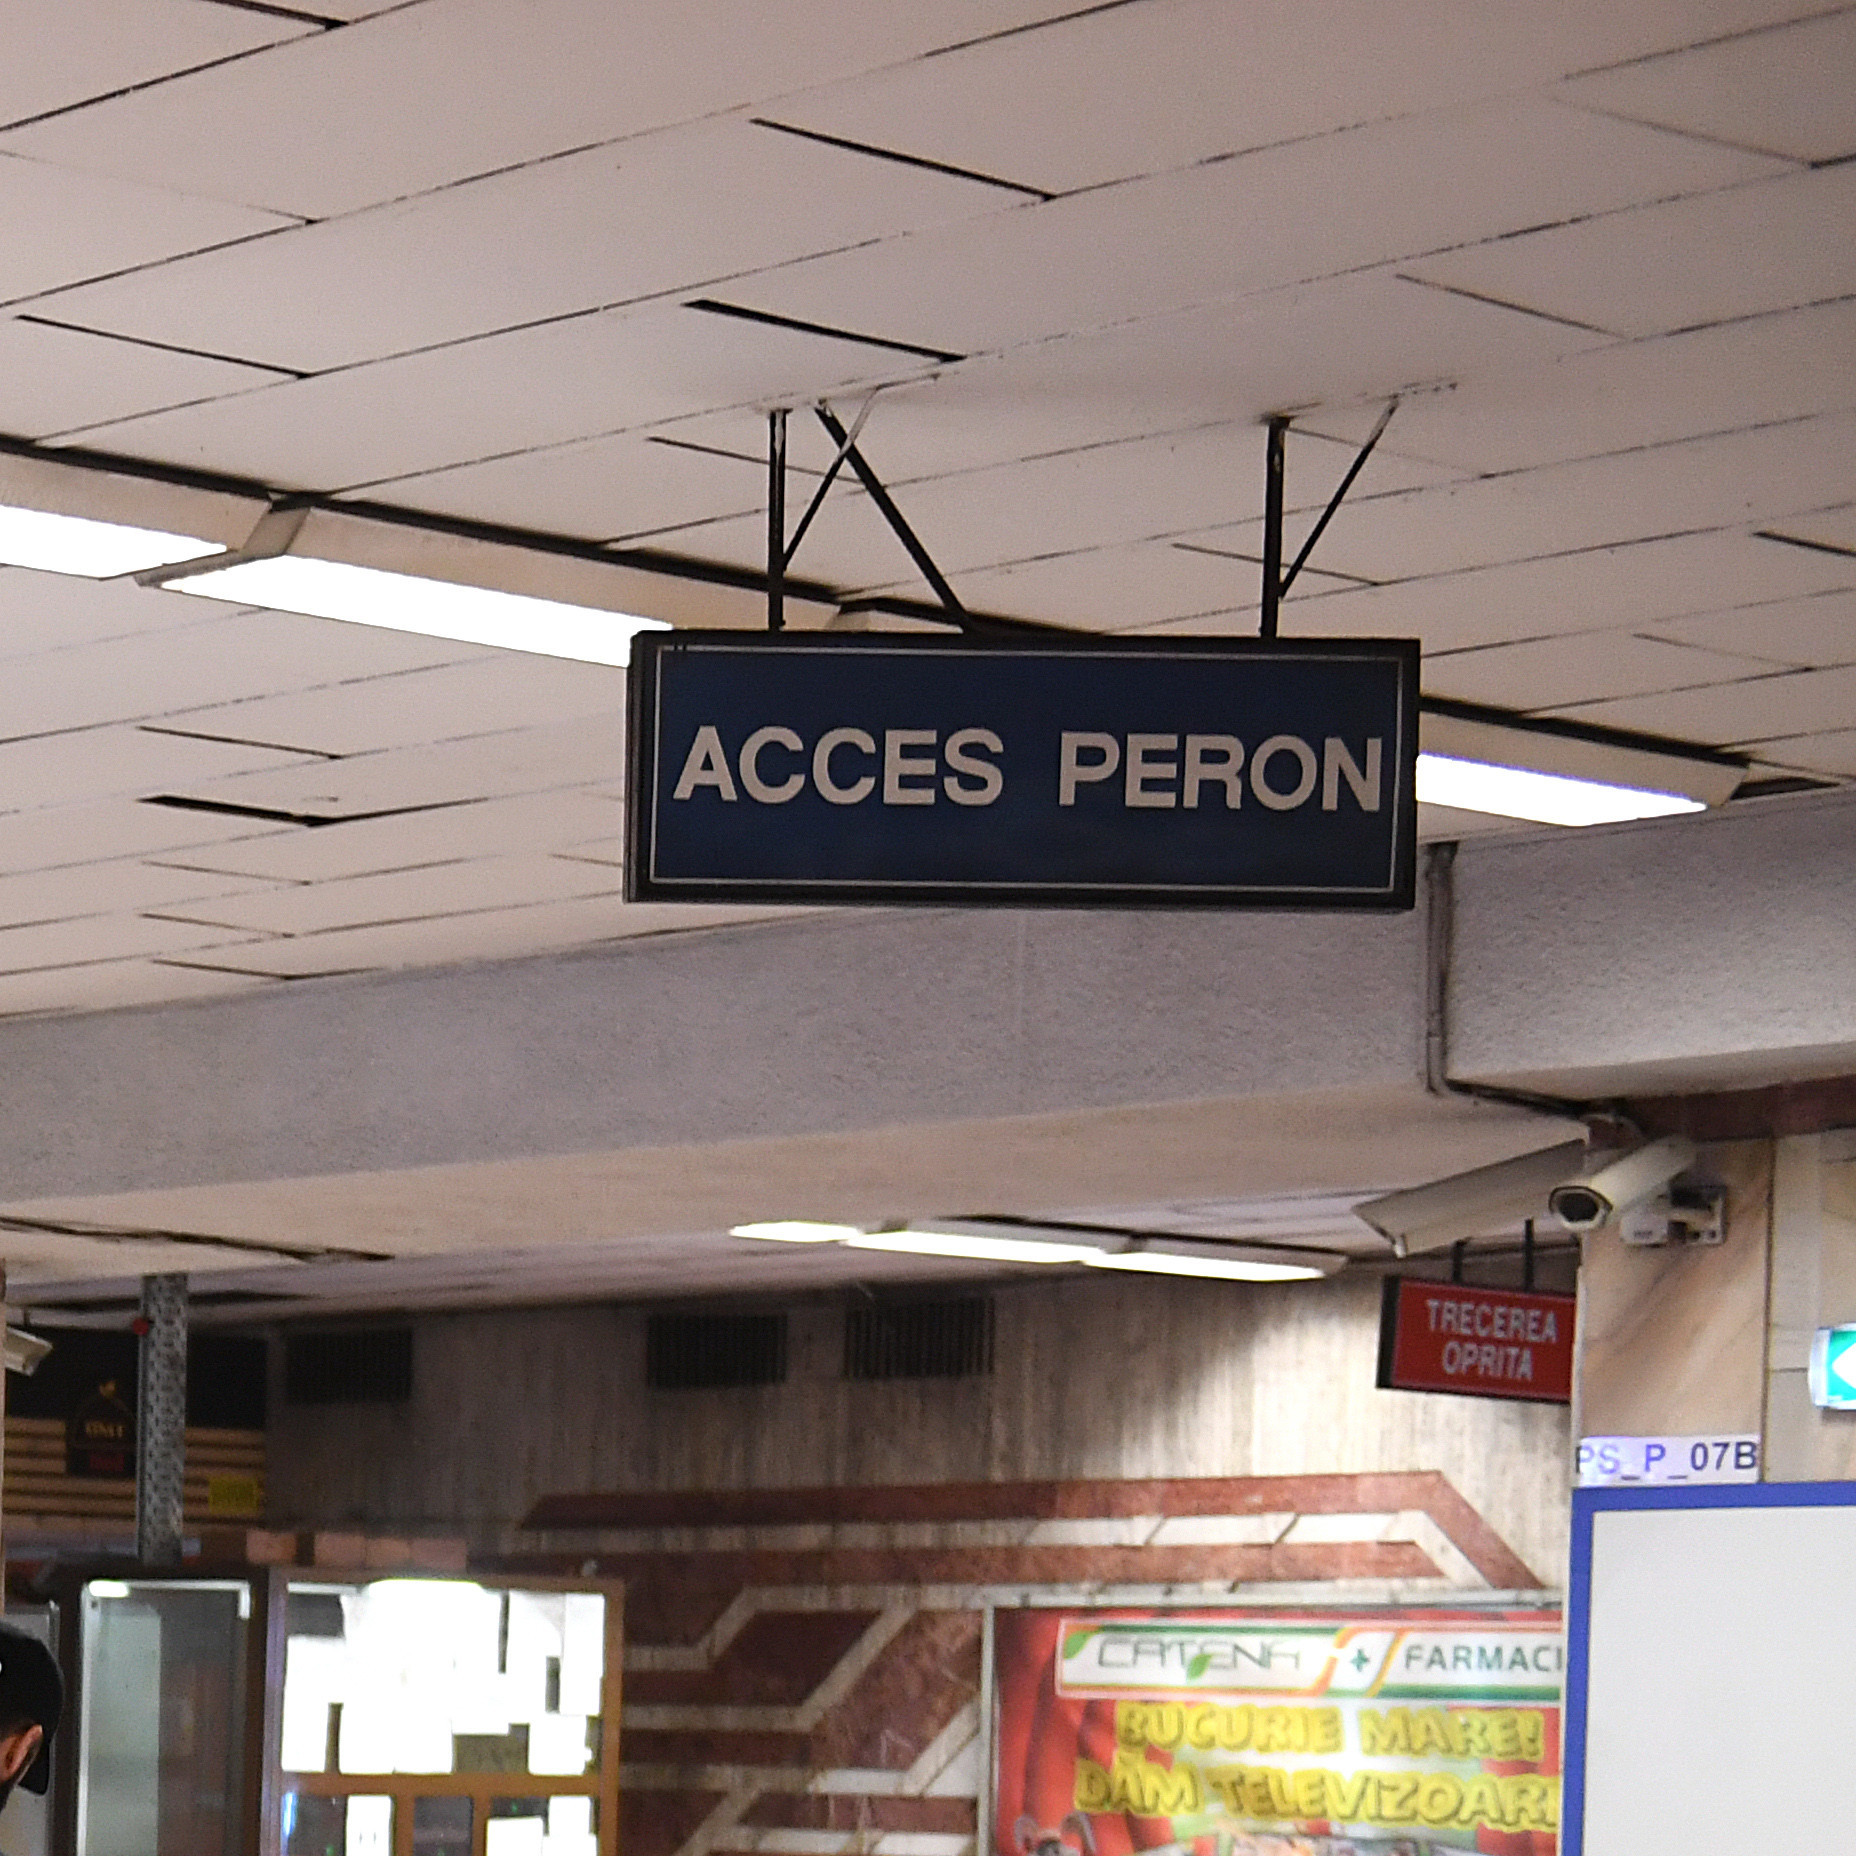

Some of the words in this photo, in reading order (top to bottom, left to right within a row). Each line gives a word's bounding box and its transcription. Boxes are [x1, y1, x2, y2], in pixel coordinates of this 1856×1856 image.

[672, 724, 1004, 807] ACCES
[1057, 730, 1384, 813] PERON
[1426, 1299, 1558, 1343] TRECEREA
[1441, 1341, 1534, 1380] OPRITA
[1096, 1636, 1301, 1670] CATENA
[1116, 1703, 1344, 1753] BUCURIE
[1360, 1708, 1543, 1759] MARE!
